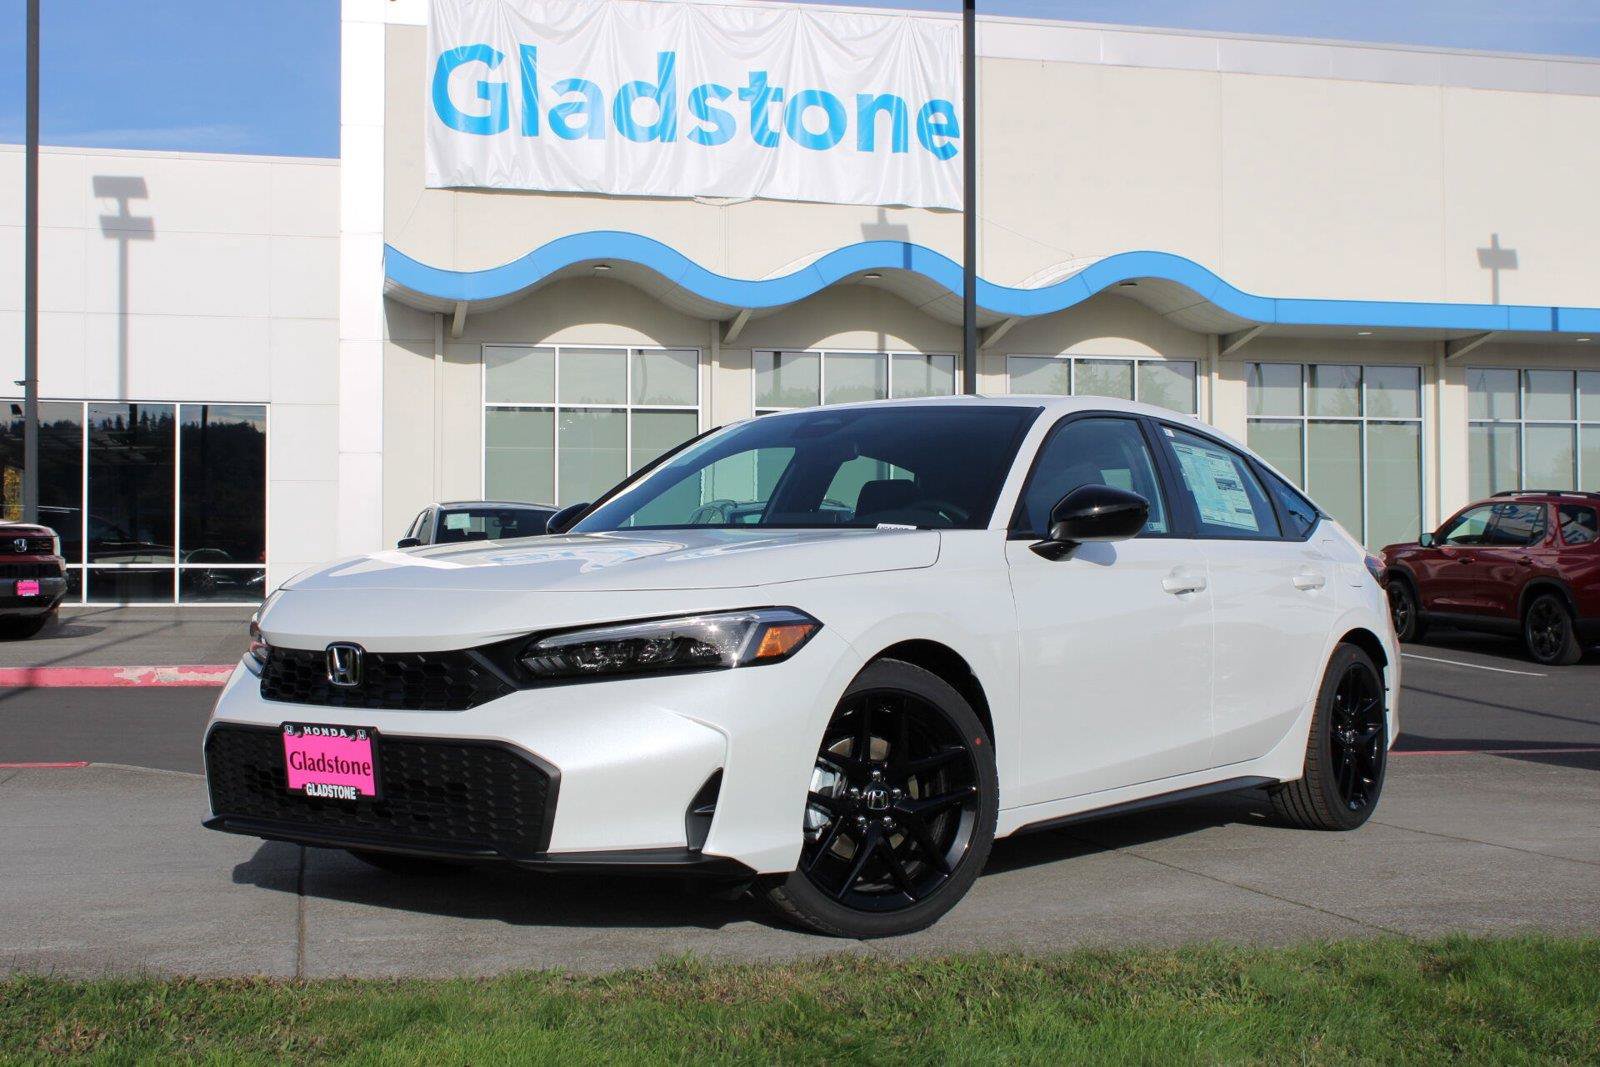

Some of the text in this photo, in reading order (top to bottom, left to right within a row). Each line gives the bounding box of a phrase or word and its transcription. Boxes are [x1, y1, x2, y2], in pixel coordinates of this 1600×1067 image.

[431, 43, 960, 161] Gladstone
[303, 726, 347, 738] HONDA
[289, 750, 371, 776] Gladstone
[306, 782, 357, 800] GLADSTONE
